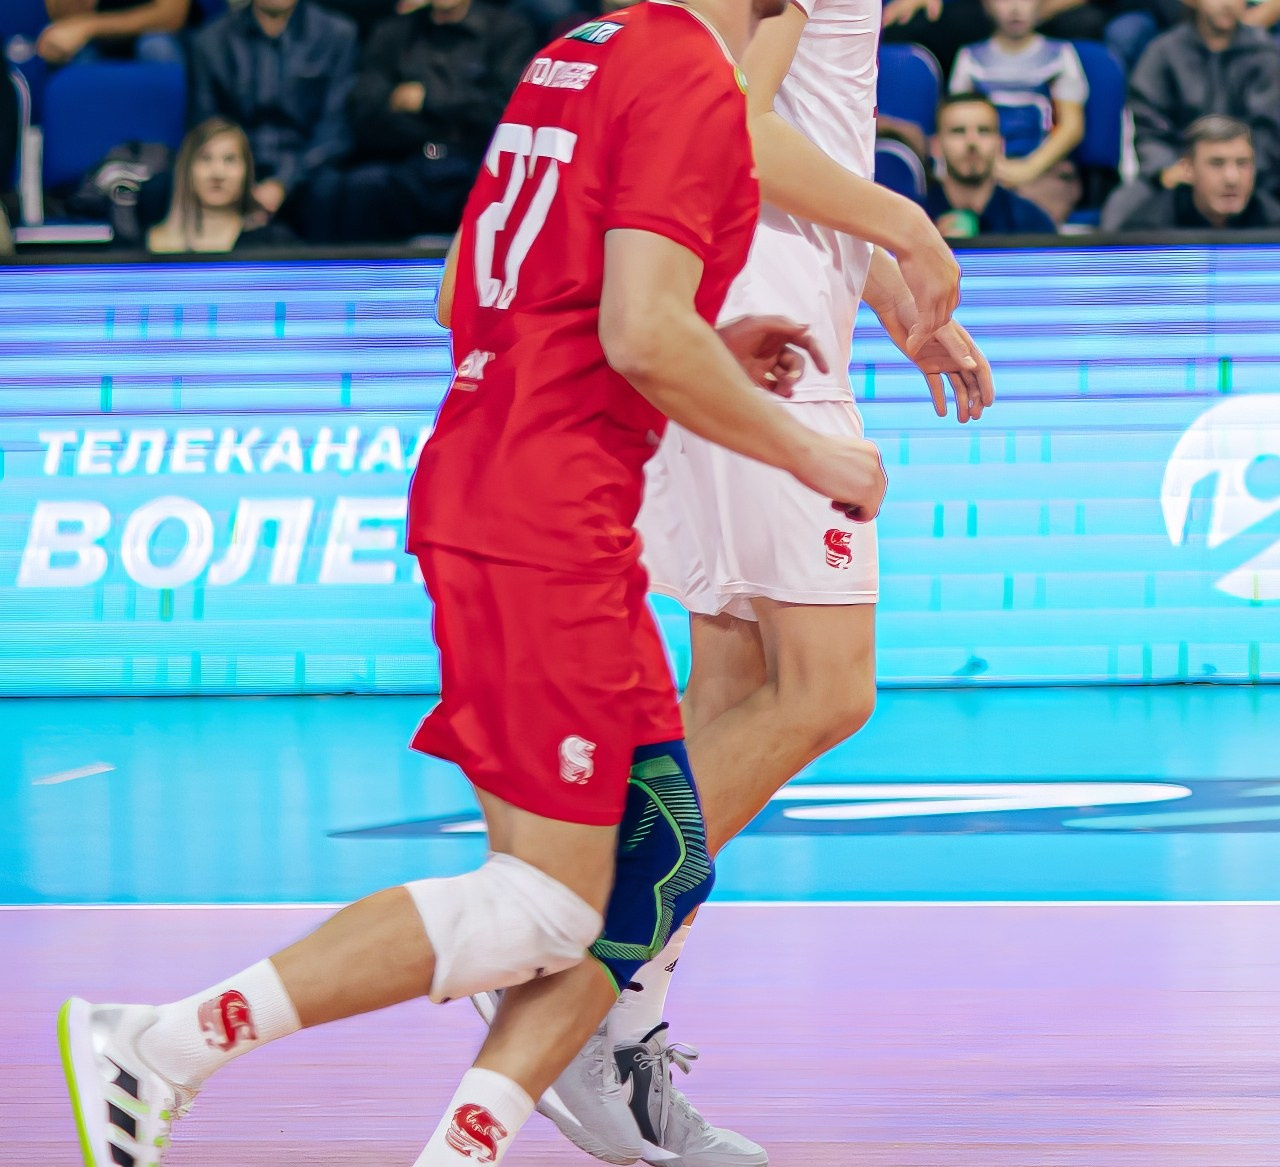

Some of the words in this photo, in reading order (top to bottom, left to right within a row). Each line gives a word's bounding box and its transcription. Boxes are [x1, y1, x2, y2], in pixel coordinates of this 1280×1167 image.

[475, 123, 578, 310] 27
[38, 426, 432, 475] ТЕЛЕКАНА
[16, 495, 425, 589] ВОЛЕ
